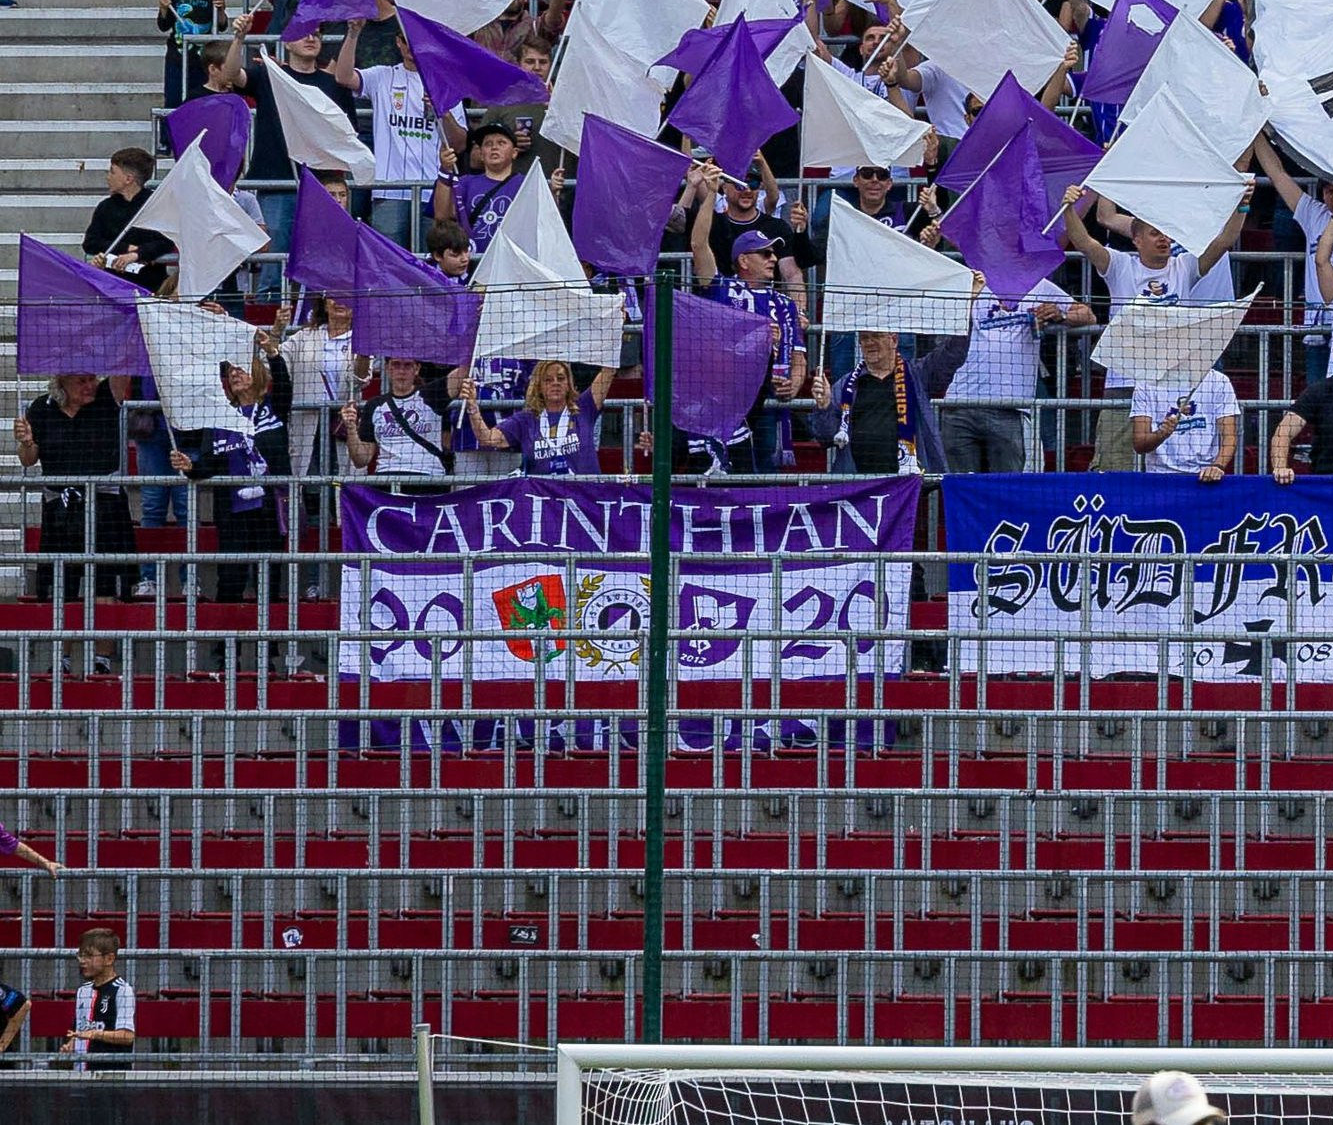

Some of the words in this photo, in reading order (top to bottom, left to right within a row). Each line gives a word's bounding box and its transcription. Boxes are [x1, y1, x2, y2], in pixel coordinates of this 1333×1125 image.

[389, 114, 438, 132] UNIBE
[366, 494, 890, 556] CARINTHIAN
[781, 579, 889, 661] 20
[680, 652, 708, 665] 2012
[1296, 642, 1333, 664] 08
